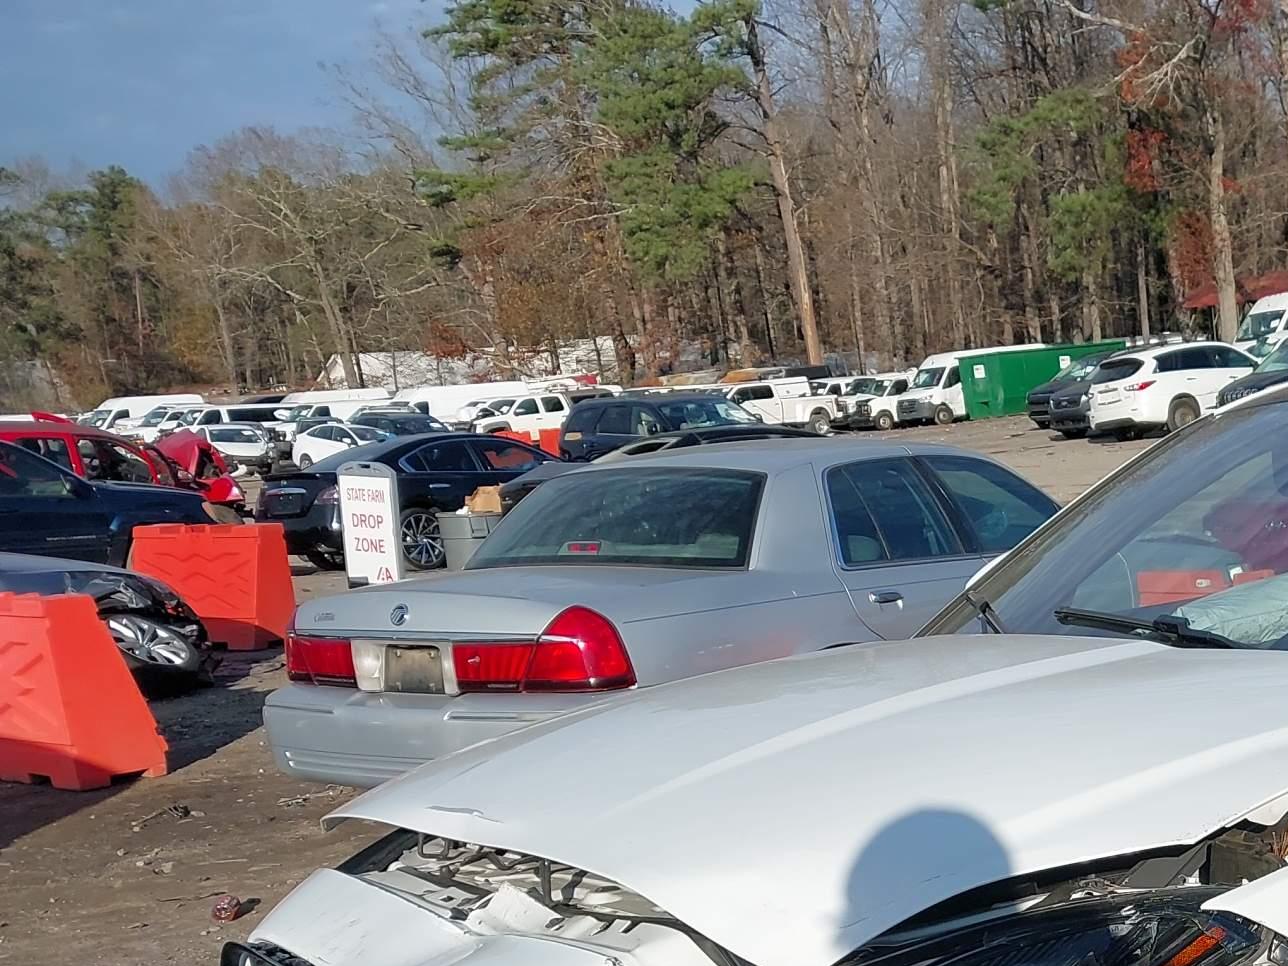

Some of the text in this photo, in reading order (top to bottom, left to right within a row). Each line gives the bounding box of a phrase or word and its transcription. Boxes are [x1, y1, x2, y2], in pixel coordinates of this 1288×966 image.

[346, 487, 385, 504] STATE FARM
[351, 513, 384, 529] DROP
[354, 537, 386, 554] ZONE
